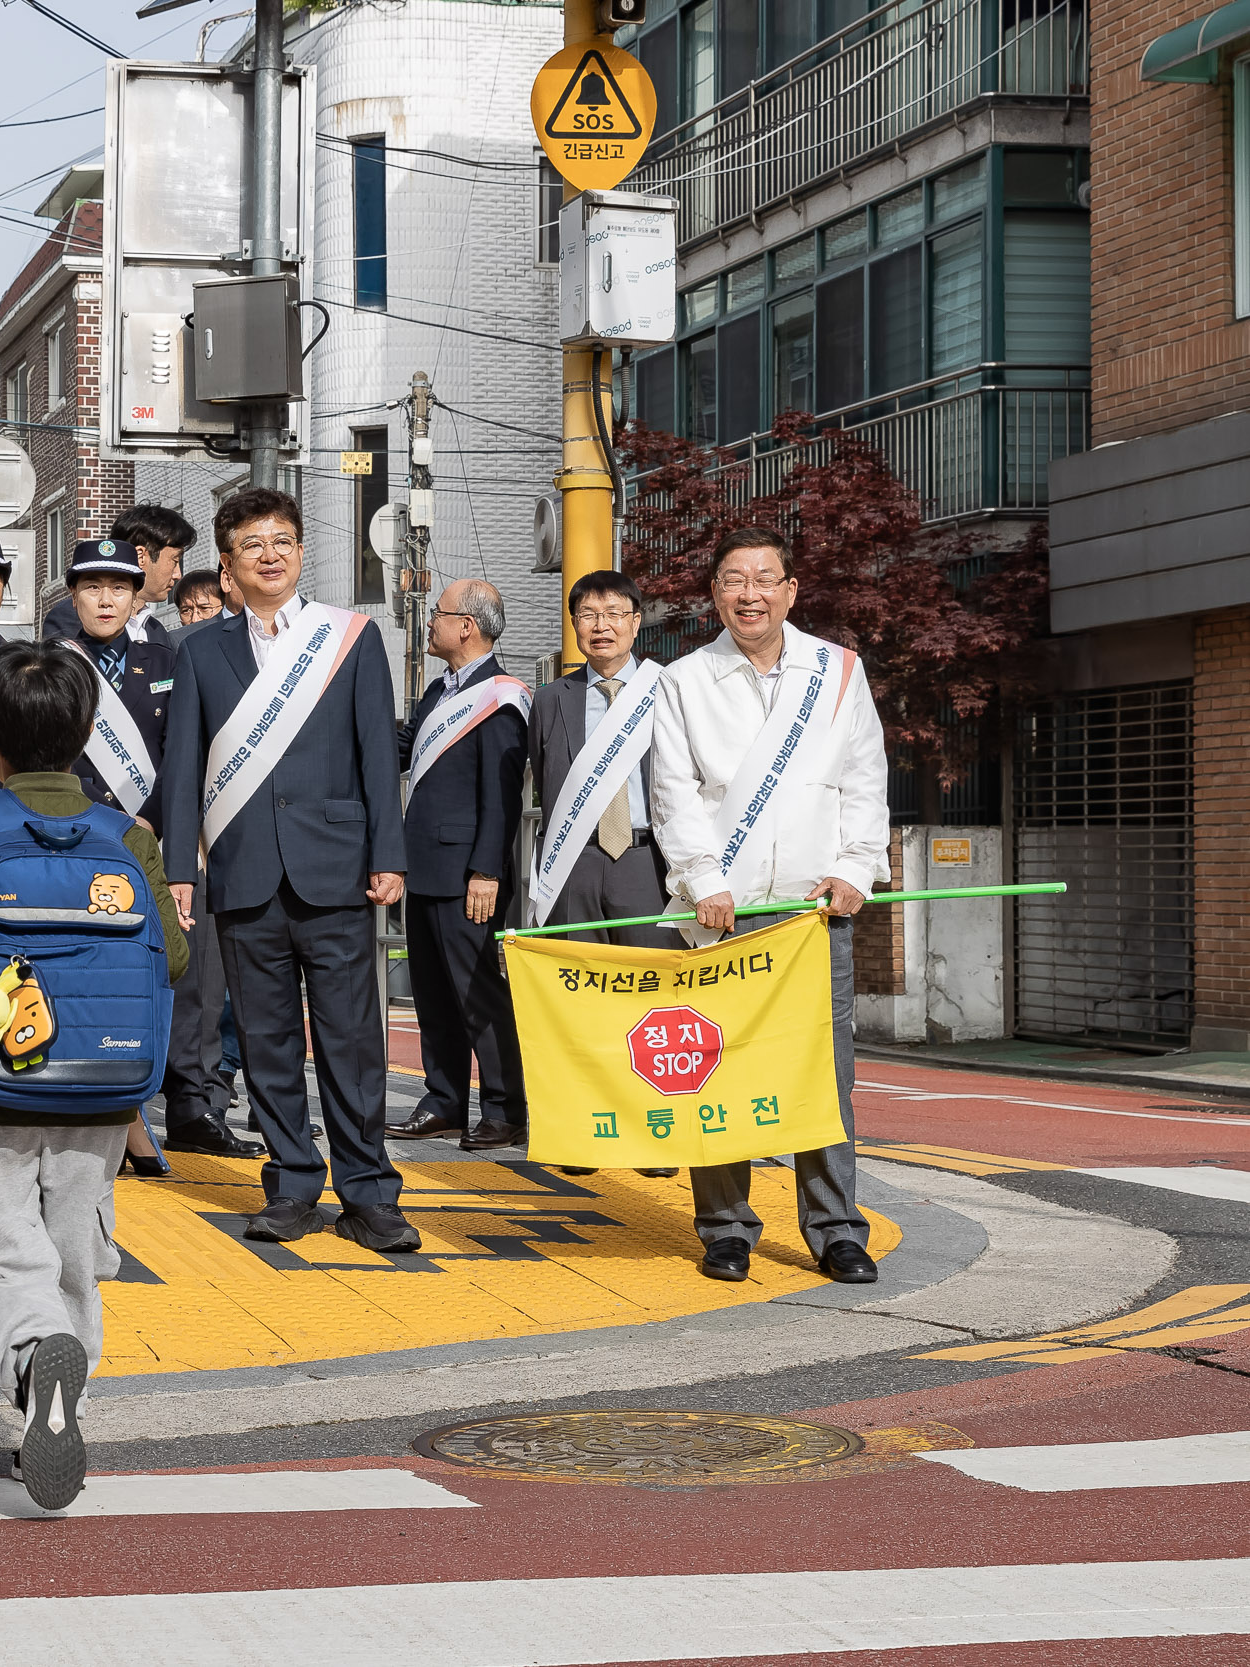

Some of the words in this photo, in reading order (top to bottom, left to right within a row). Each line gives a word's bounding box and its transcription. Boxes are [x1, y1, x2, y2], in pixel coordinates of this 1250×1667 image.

[573, 114, 614, 130] SOS
[563, 143, 625, 160] 긴급신고
[131, 406, 154, 419] 3M
[305, 622, 332, 654] 소중한
[276, 653, 314, 699] 아이들의
[621, 695, 654, 737] 아이들의
[796, 675, 823, 724] 아이들의
[95, 718, 132, 765] 안전하게
[245, 696, 286, 749] 등하굣길
[212, 746, 252, 793] 안전하게
[592, 733, 627, 778] 등하굣길
[771, 722, 805, 776] 등하굣길
[567, 776, 598, 822] 안전하게
[739, 774, 779, 829] 안전하게
[542, 818, 573, 875] 지켜주세요
[558, 966, 661, 993] 정지선을
[673, 951, 774, 989] 지킵시다
[97, 1035, 141, 1048] Sammies
[652, 1051, 704, 1077] STOP
